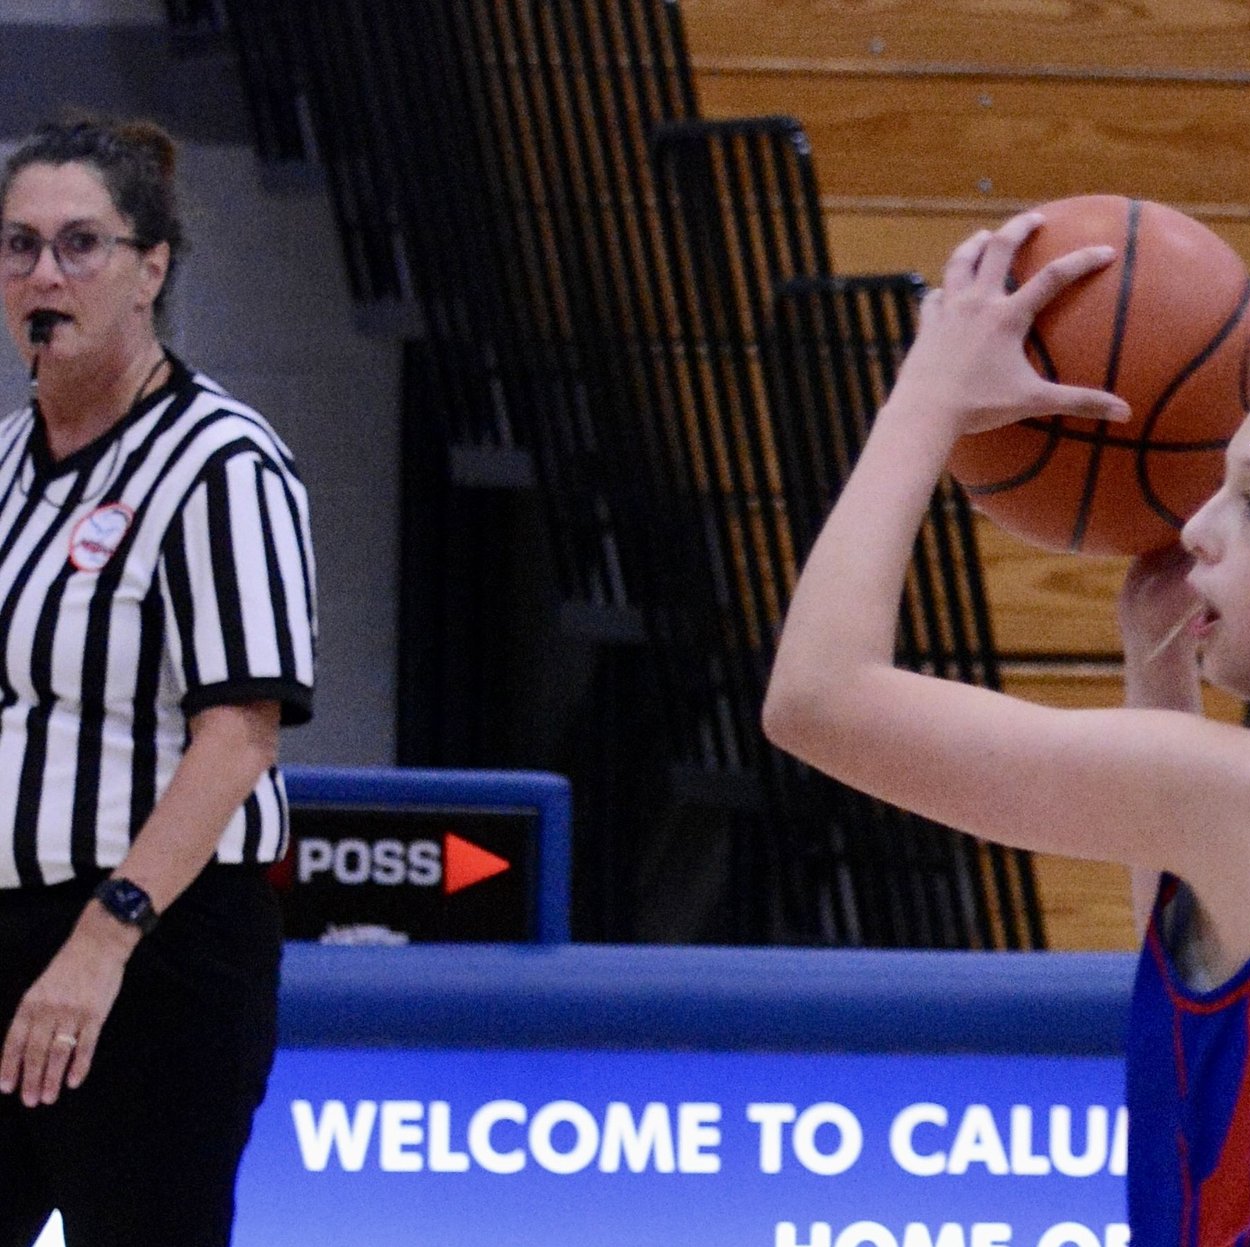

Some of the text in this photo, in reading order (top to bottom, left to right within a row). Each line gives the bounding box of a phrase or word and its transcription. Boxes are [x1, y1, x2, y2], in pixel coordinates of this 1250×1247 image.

[298, 838, 443, 886] POSS
[291, 1100, 721, 1175] WELCOME
[746, 1102, 863, 1176] TO
